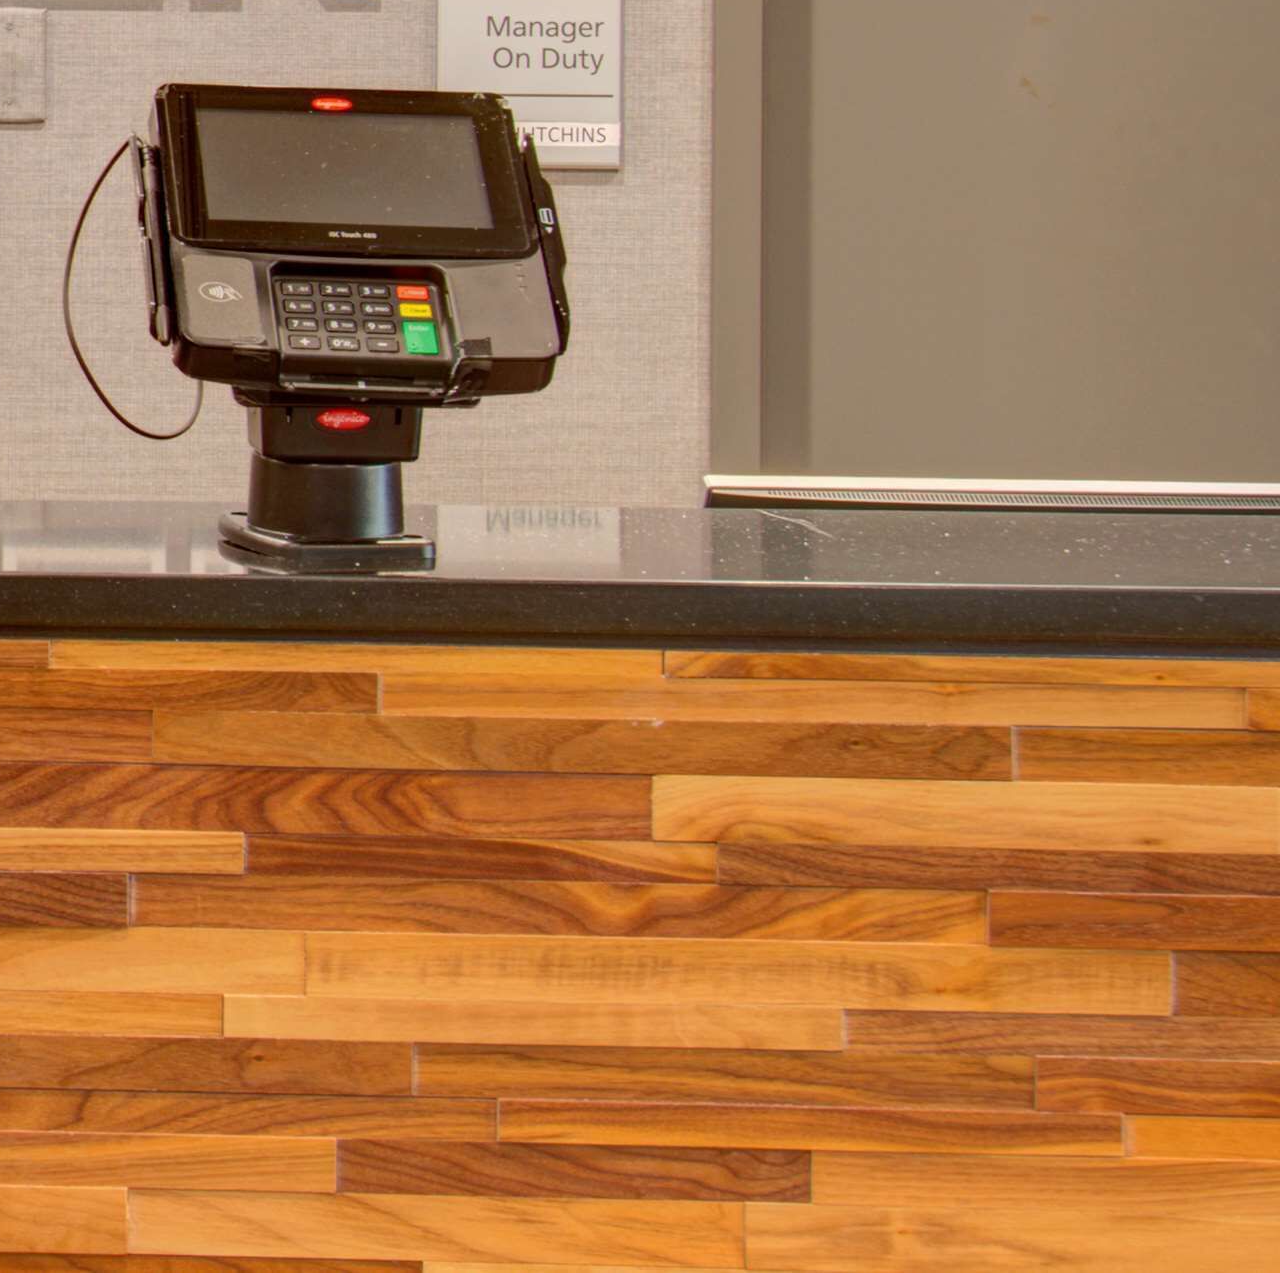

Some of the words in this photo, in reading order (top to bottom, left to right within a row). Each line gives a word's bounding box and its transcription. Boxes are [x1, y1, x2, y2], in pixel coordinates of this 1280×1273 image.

[486, 15, 605, 44] Manager
[492, 47, 531, 69] On
[541, 47, 605, 76] Duty
[517, 126, 607, 143] TCHINS
